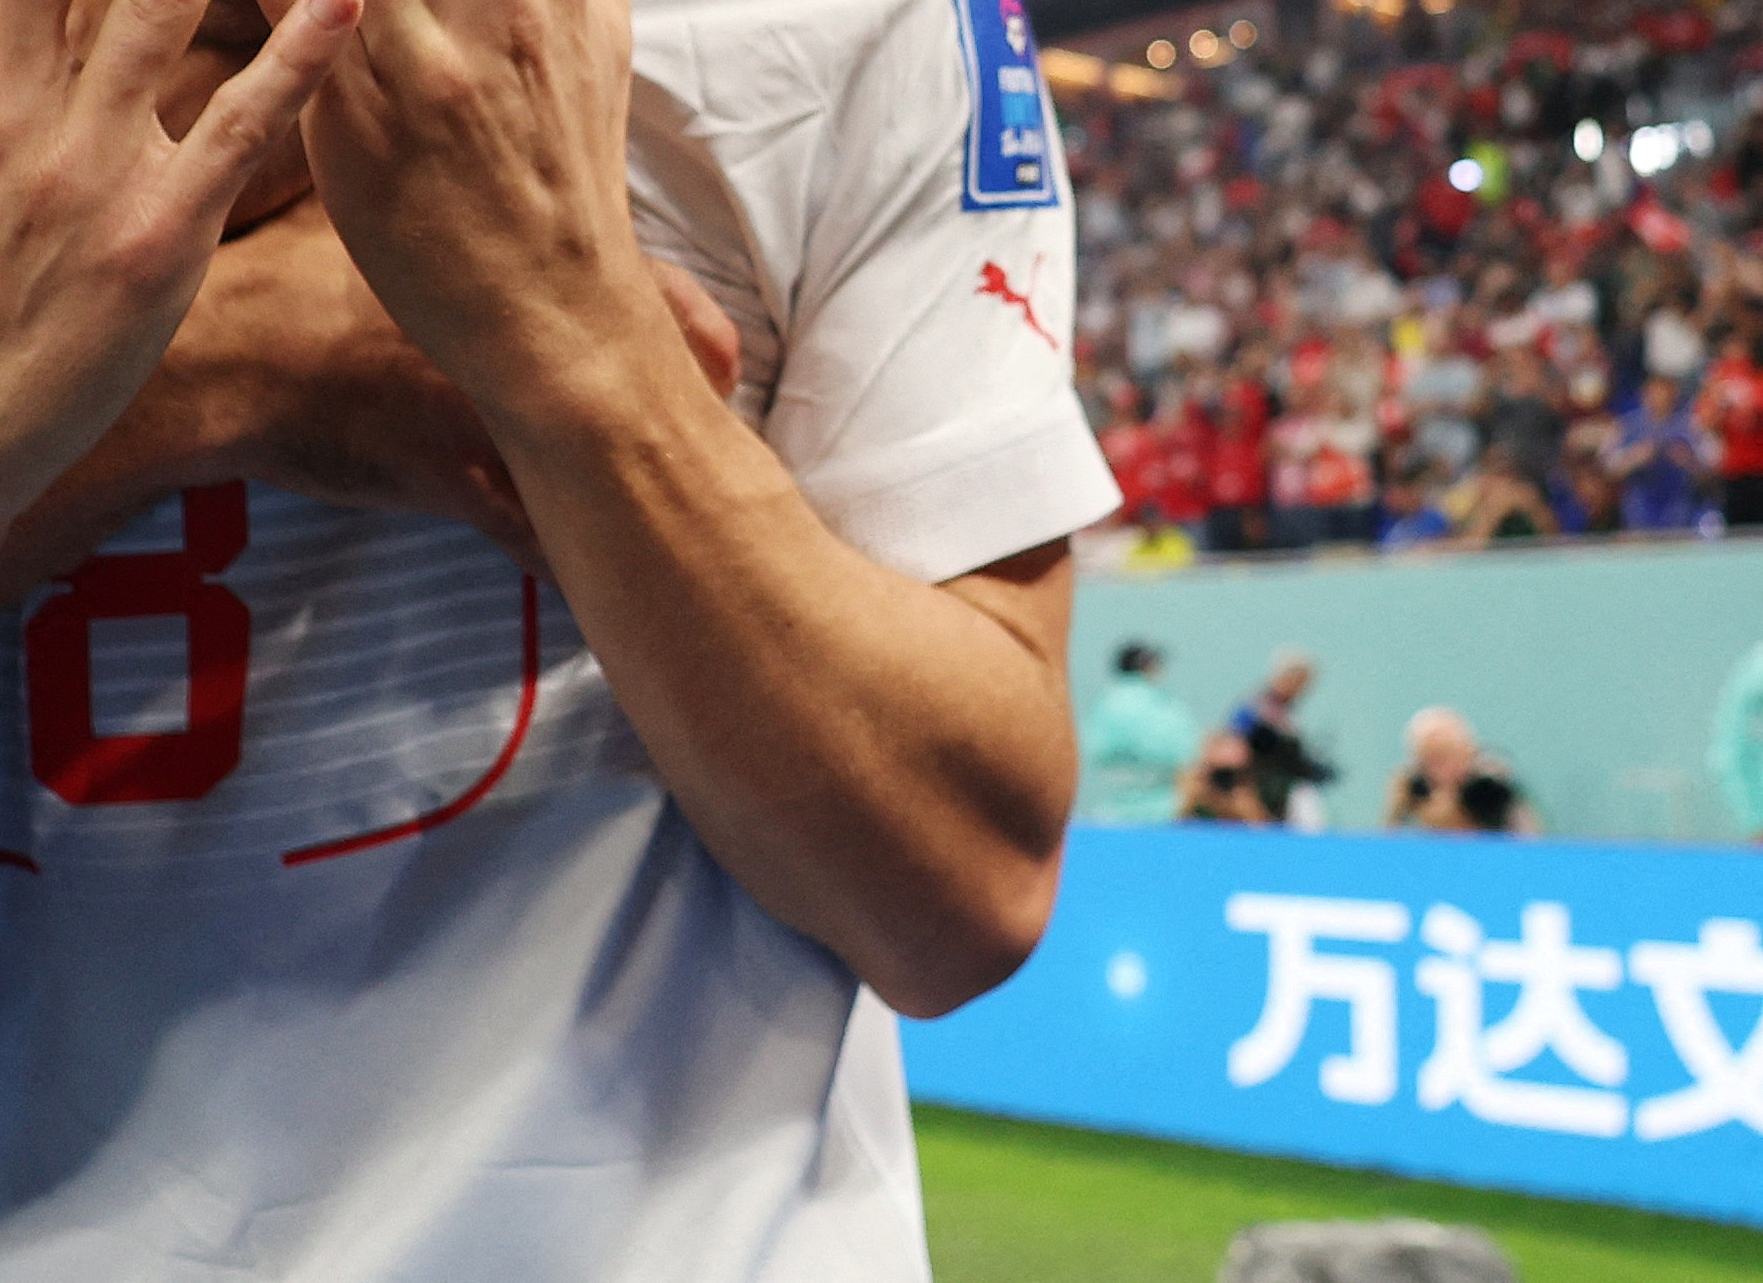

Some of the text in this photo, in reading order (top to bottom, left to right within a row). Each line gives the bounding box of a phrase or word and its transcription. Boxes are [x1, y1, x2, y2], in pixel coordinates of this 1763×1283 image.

[24, 477, 251, 806] 8
[1224, 891, 1763, 1142] 万达文
